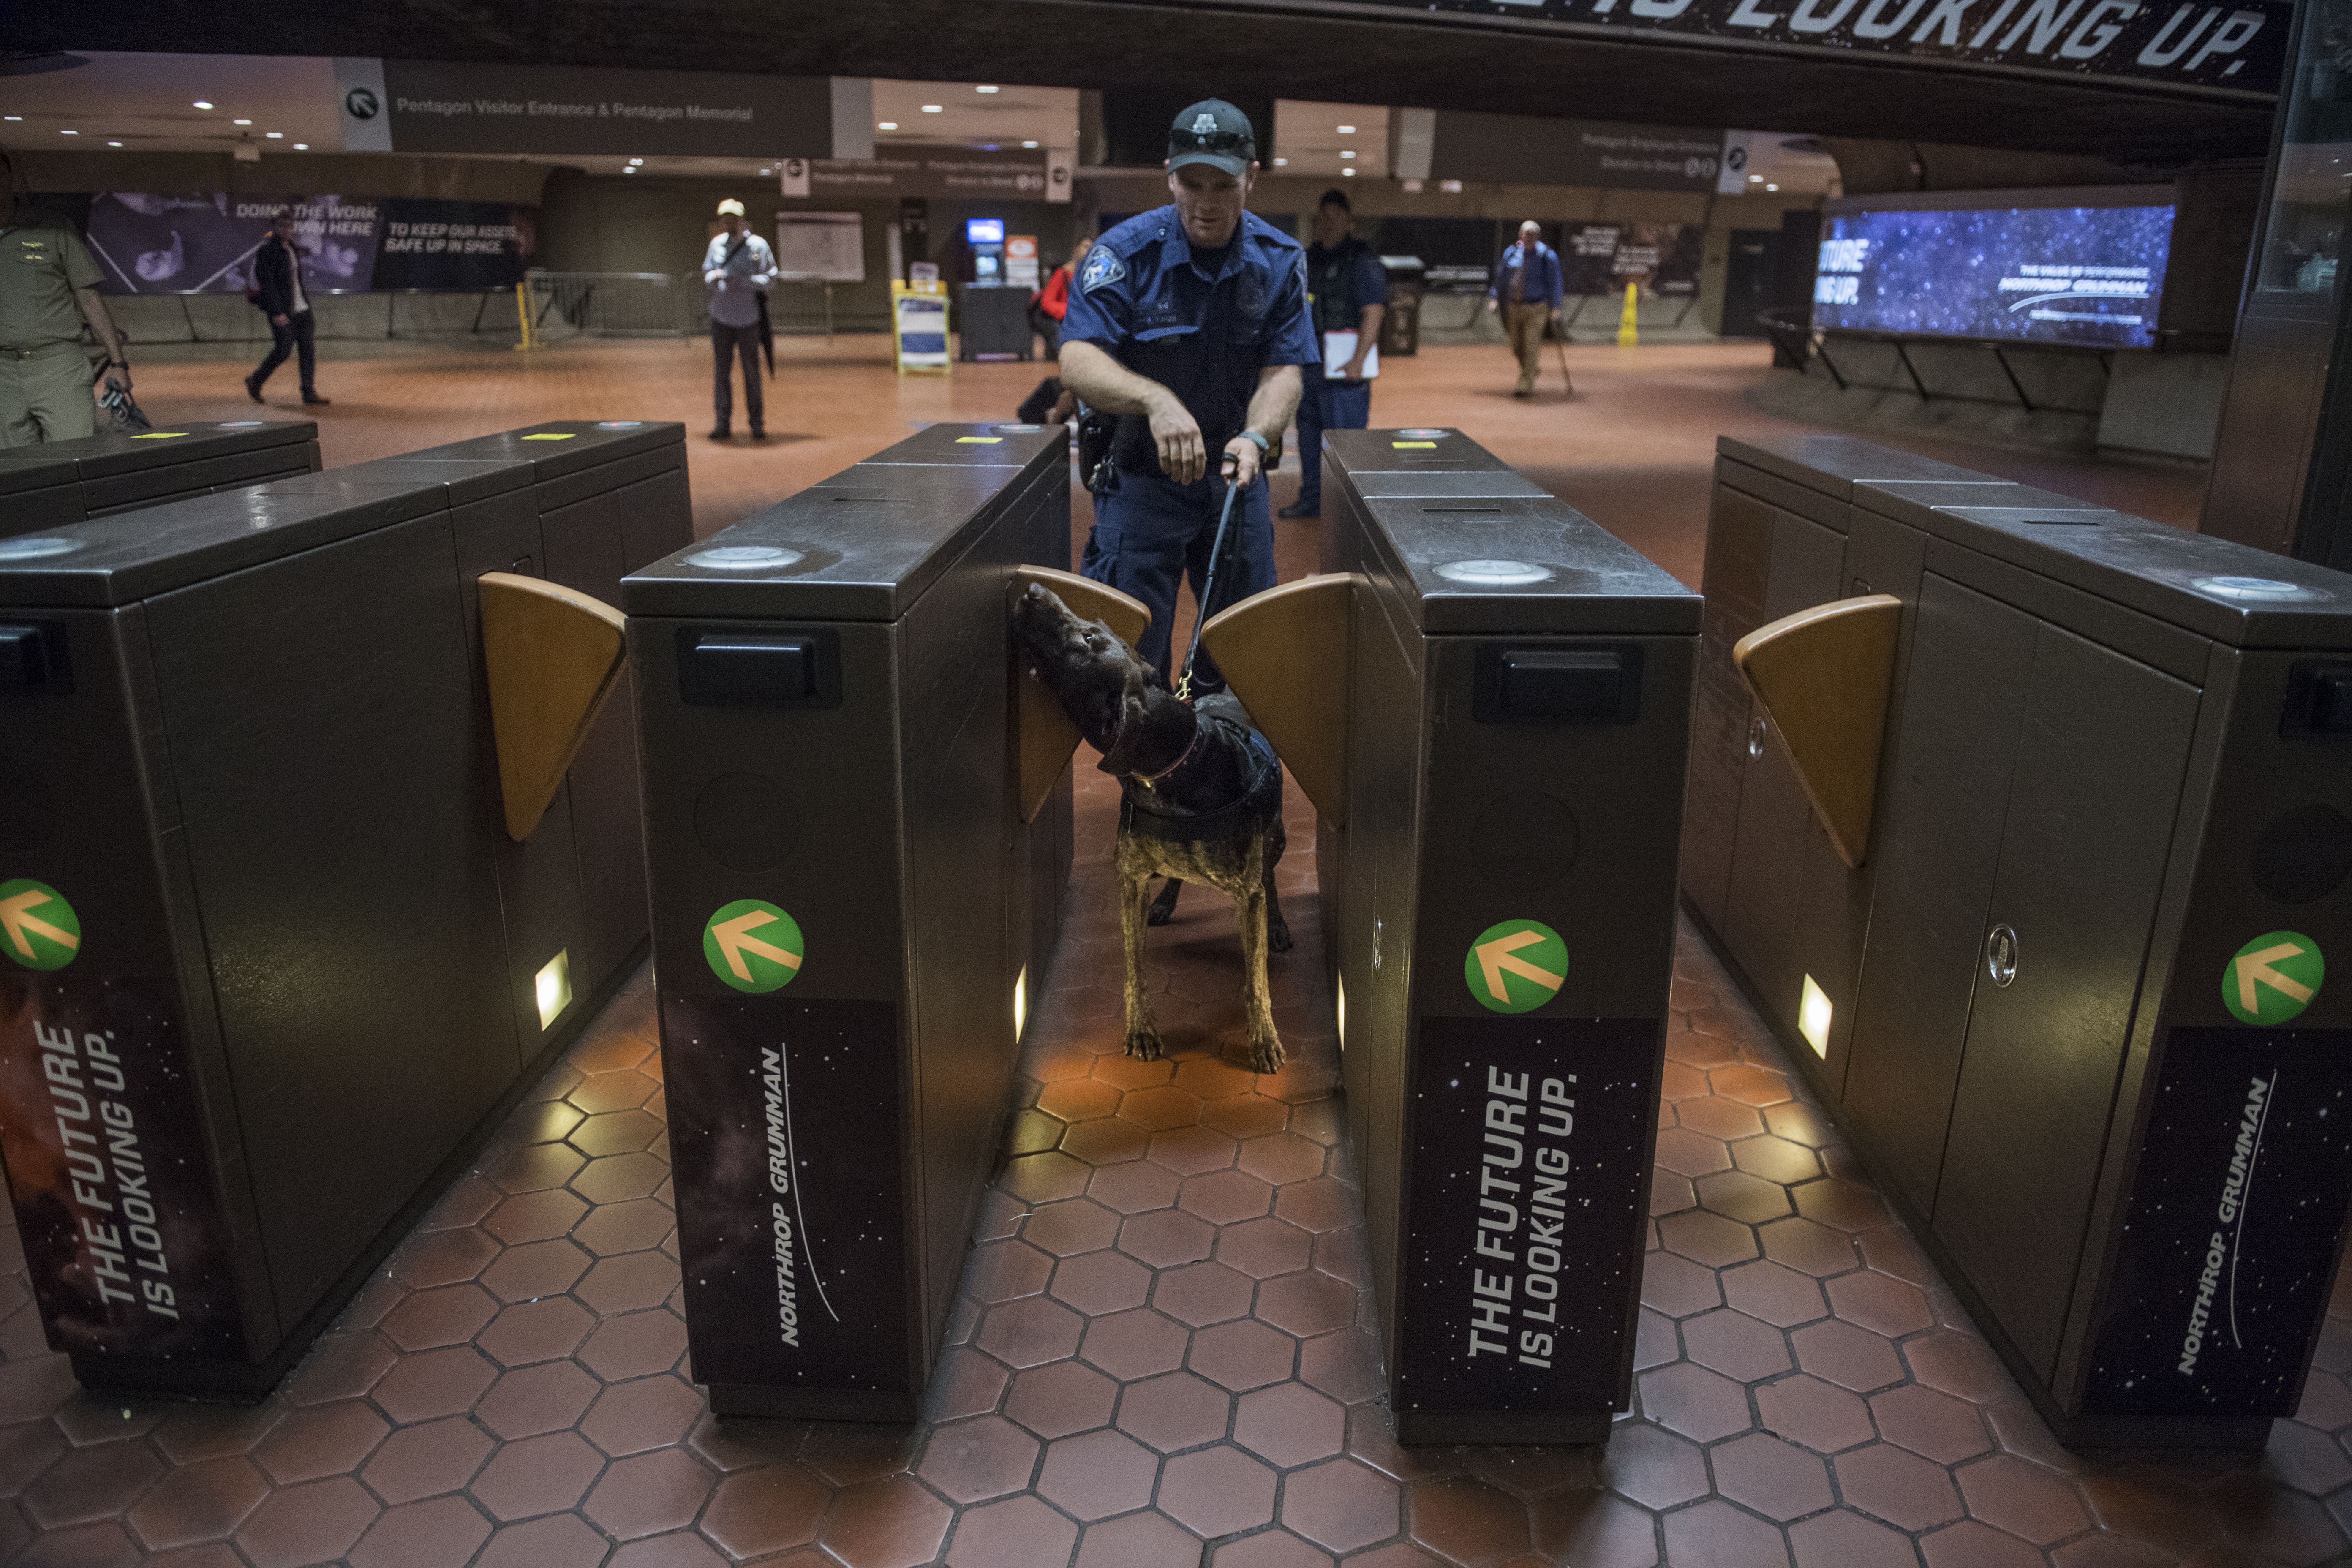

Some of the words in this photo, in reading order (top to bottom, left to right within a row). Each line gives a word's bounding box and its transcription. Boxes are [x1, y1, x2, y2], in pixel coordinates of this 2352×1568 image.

[2136, 1, 2267, 76] UP.
[396, 98, 472, 117] Pentagon
[474, 99, 524, 115] Visitor
[527, 100, 595, 117] Entrance
[598, 102, 610, 117] &
[612, 103, 684, 121] Pentagon
[686, 105, 754, 121] Memorial
[292, 219, 327, 234] WN
[329, 220, 374, 237] HERE
[294, 204, 325, 220] THE
[328, 205, 378, 220] WORK
[384, 237, 424, 253] SAFE
[425, 237, 447, 253] UP
[447, 238, 462, 254] IN
[389, 222, 409, 237] TO
[410, 223, 449, 238] KEEP
[448, 223, 477, 238] OUR
[477, 225, 517, 240] ASSETS
[83, 1029, 126, 1092] UP.
[33, 1019, 113, 1212] FUTURE
[761, 1047, 789, 1195] GRUMMAN
[1538, 1073, 1577, 1137] UP.
[100, 1100, 169, 1273] LOOKING
[1475, 1065, 1529, 1261] FUTURE
[81, 1216, 135, 1304] THE
[1523, 1147, 1570, 1323] LOOKING
[2177, 1231, 2227, 1376] NORTHROP
[2218, 1077, 2268, 1224] GRUMMAN
[147, 1279, 180, 1320] IS
[772, 1202, 799, 1348] NORTHROP
[1467, 1268, 1514, 1357] THE
[1519, 1330, 1553, 1369] IS
